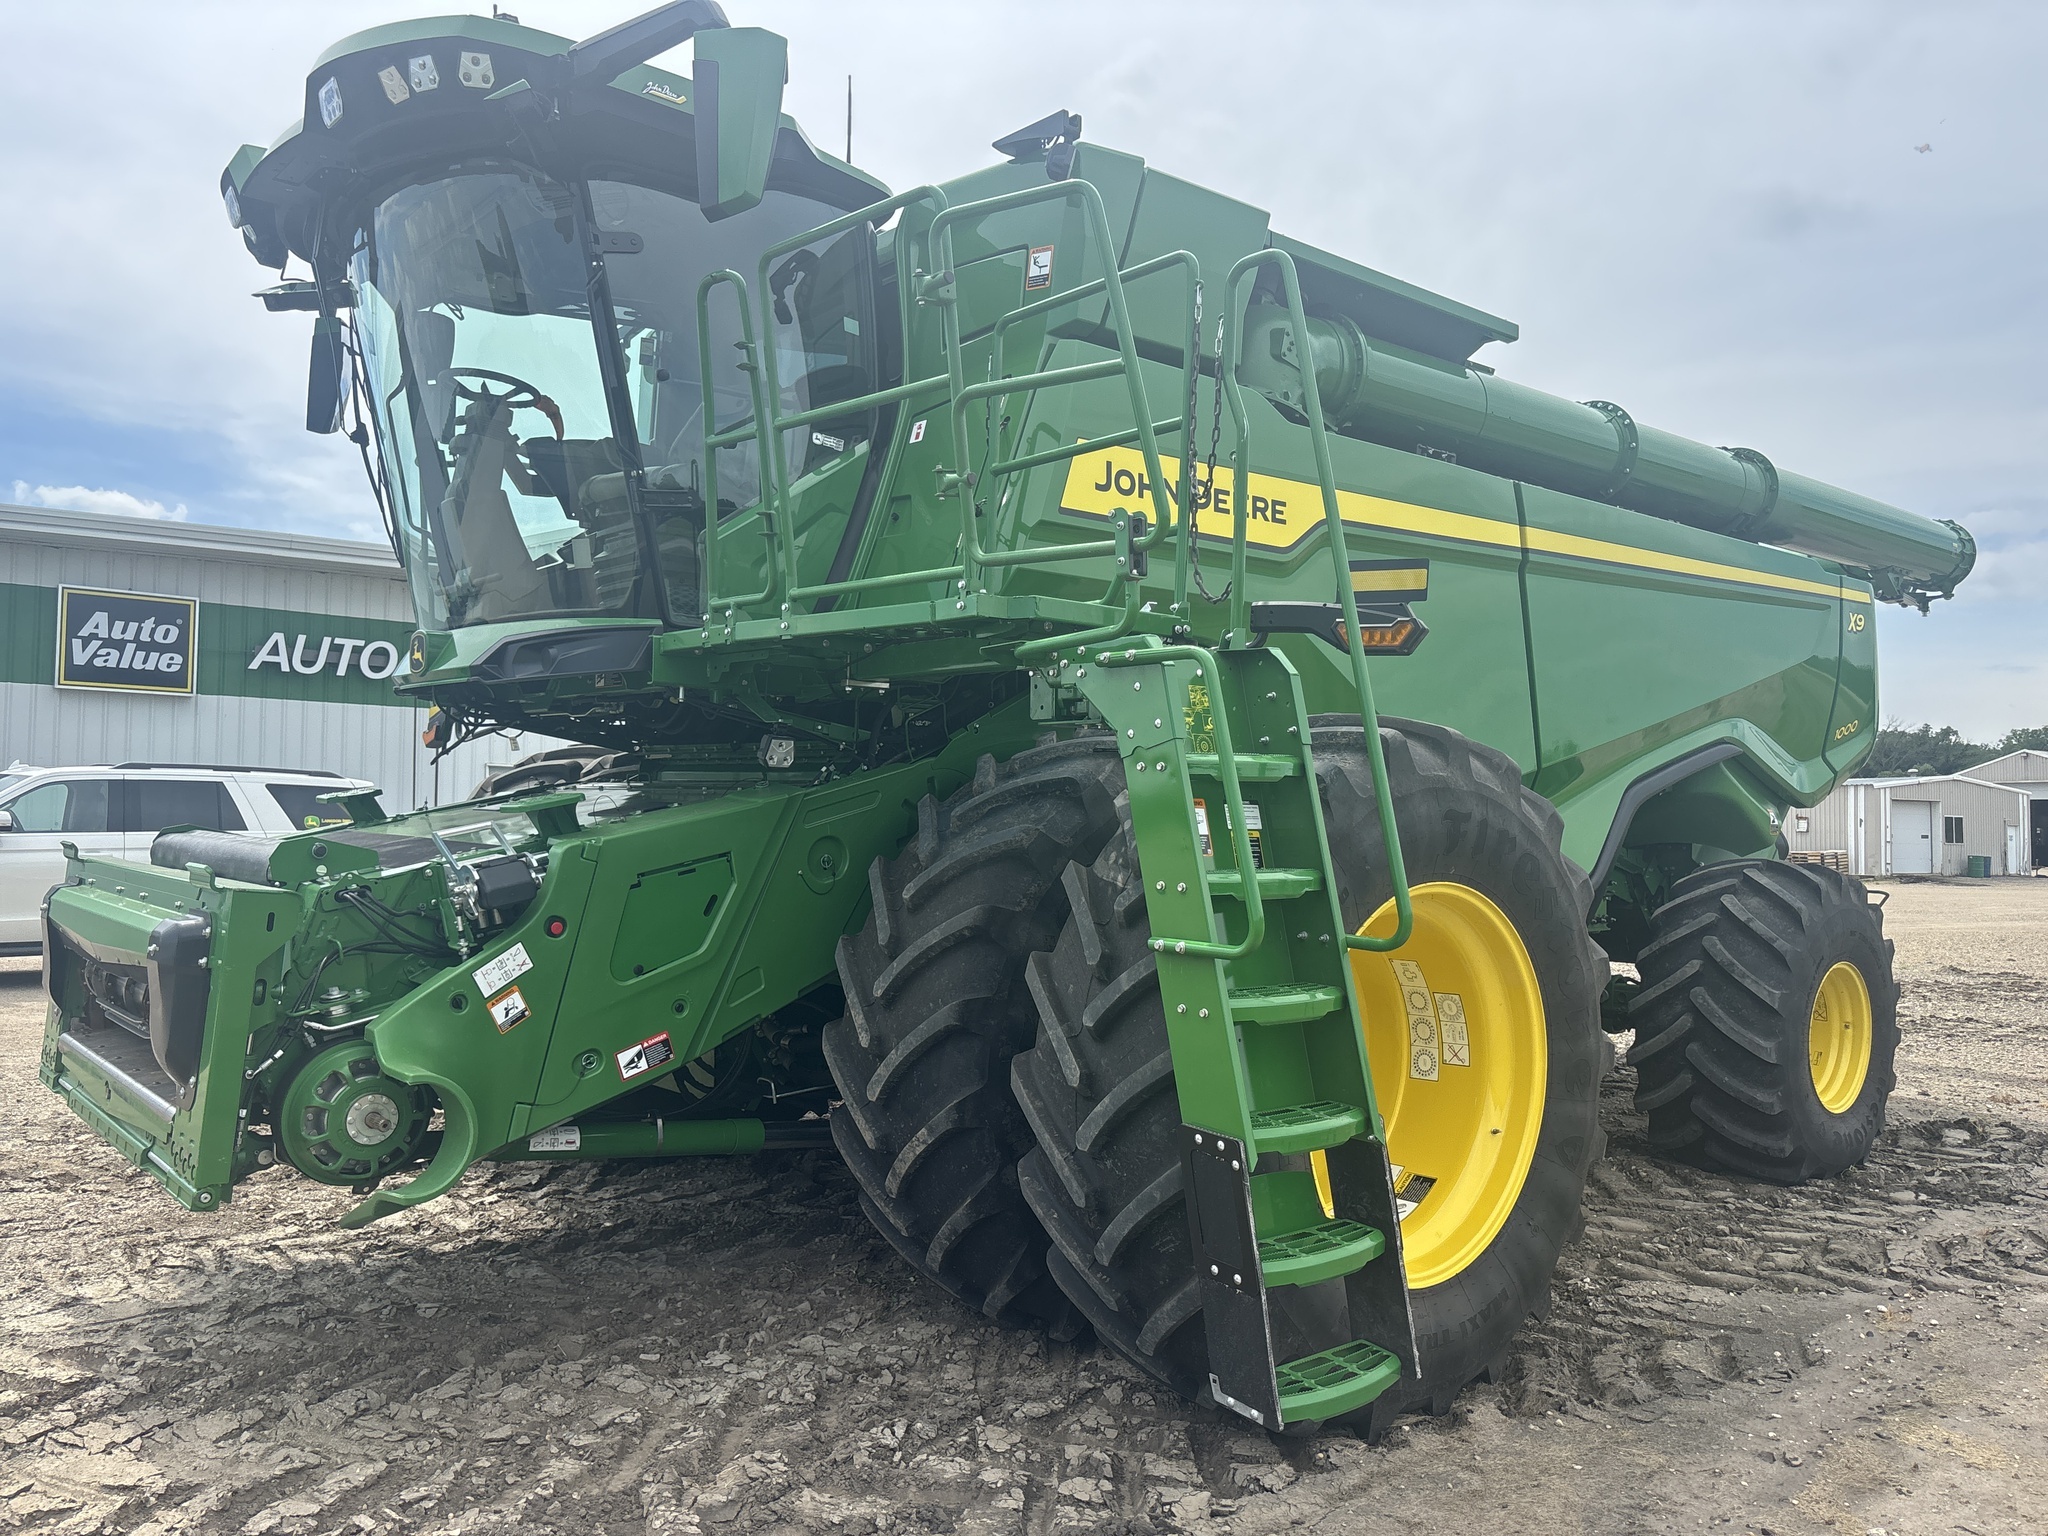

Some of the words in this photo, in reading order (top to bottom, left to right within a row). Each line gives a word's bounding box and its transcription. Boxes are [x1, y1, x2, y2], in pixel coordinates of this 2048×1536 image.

[1094, 460, 1183, 506] JOHN
[1192, 478, 1287, 525] DERE
[77, 611, 179, 644] Auto
[1847, 612, 1865, 632] X9
[72, 638, 183, 672] Value
[248, 632, 399, 680] AUTO
[1834, 719, 1858, 741] 1000
[648, 1033, 667, 1045] DANGER
[1396, 1173, 1412, 1193] CAUTION
